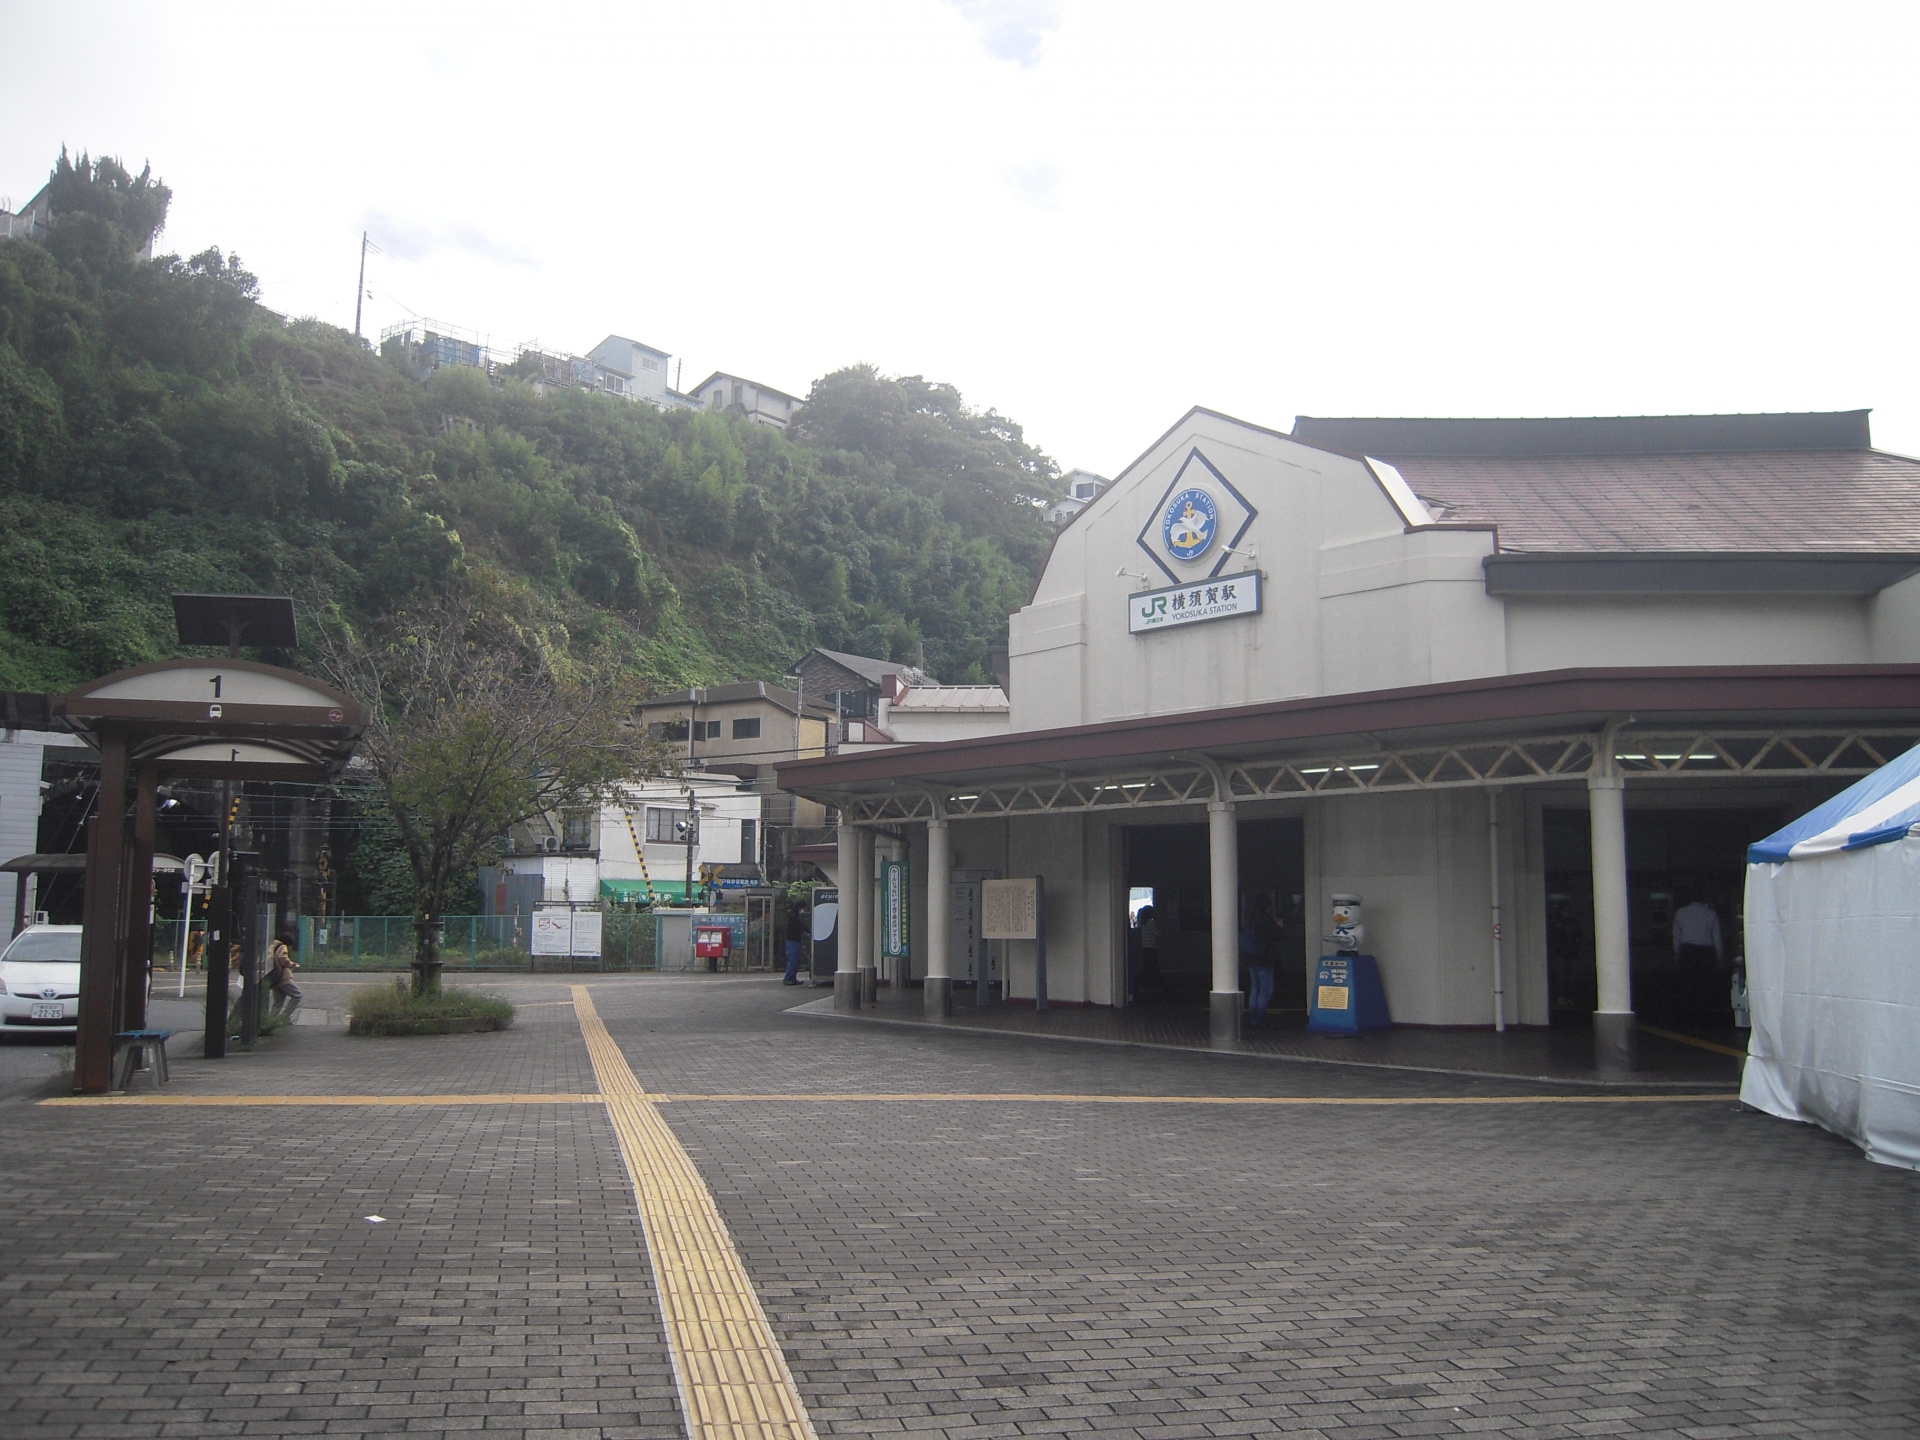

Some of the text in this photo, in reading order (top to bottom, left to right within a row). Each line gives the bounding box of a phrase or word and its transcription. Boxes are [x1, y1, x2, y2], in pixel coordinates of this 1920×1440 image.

[1165, 492, 1214, 530] YOKOSUKA STATION
[1141, 596, 1167, 617] JR
[1171, 584, 1237, 611] 横須賀駅
[1172, 602, 1238, 621] YOKOSUKA STATION
[209, 675, 222, 698] 1
[38, 1010, 61, 1018] 22-25
